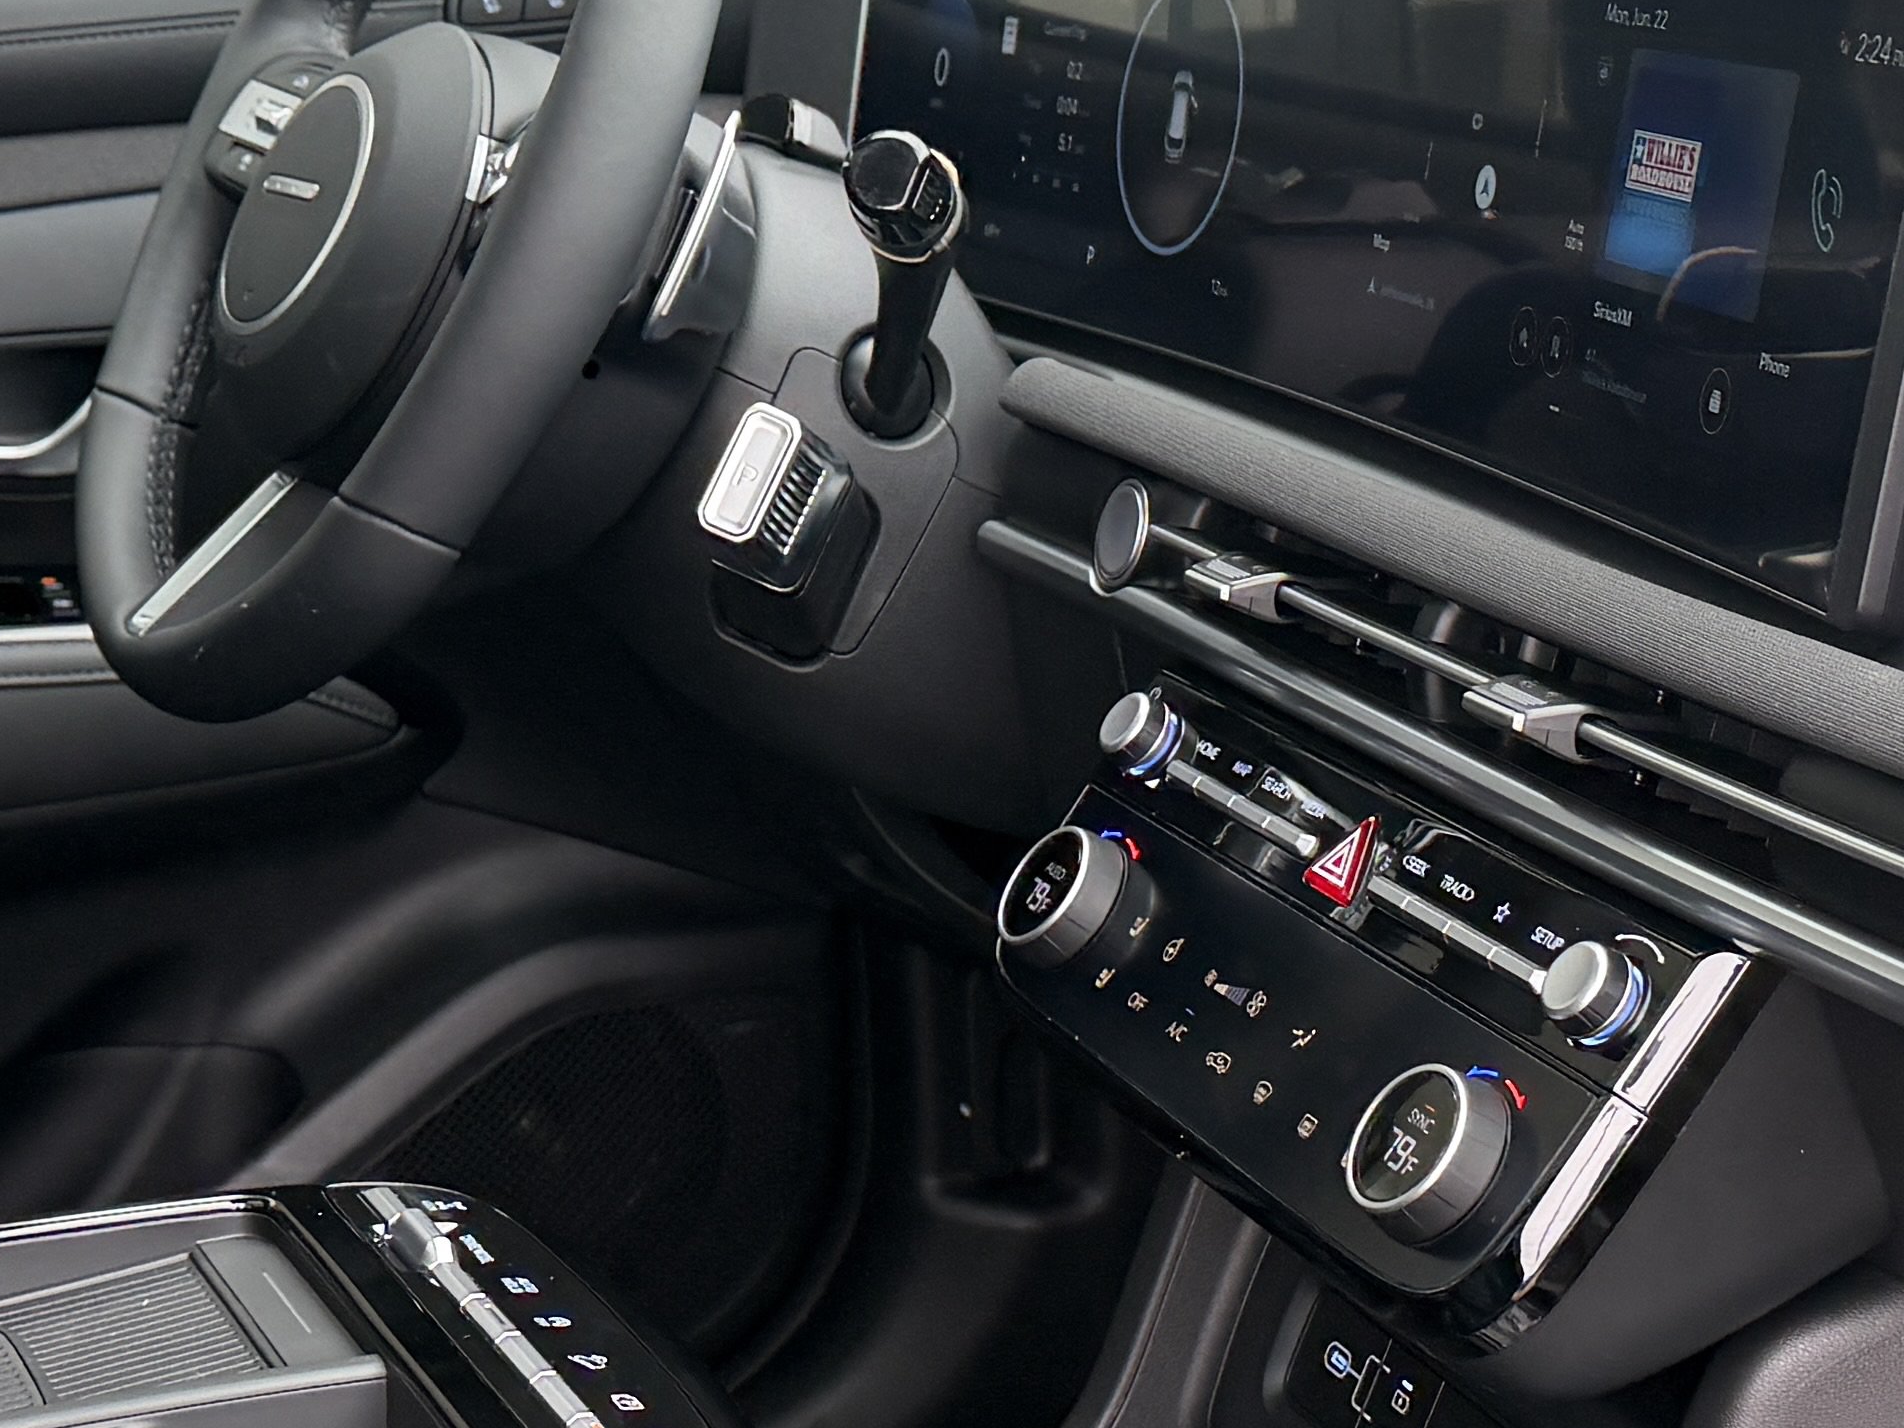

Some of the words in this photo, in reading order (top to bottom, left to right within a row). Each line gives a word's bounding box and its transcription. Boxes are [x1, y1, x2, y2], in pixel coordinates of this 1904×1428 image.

[1653, 9, 1669, 30] 22
[1854, 32, 1892, 64] 2:24
[934, 47, 950, 87] 0
[1758, 352, 1792, 380] Phone
[731, 460, 760, 487] P
[1530, 926, 1565, 951] SETUP
[1127, 991, 1150, 1012] OFF
[1165, 1021, 1188, 1042] A/C
[1407, 1107, 1436, 1135] SYNC
